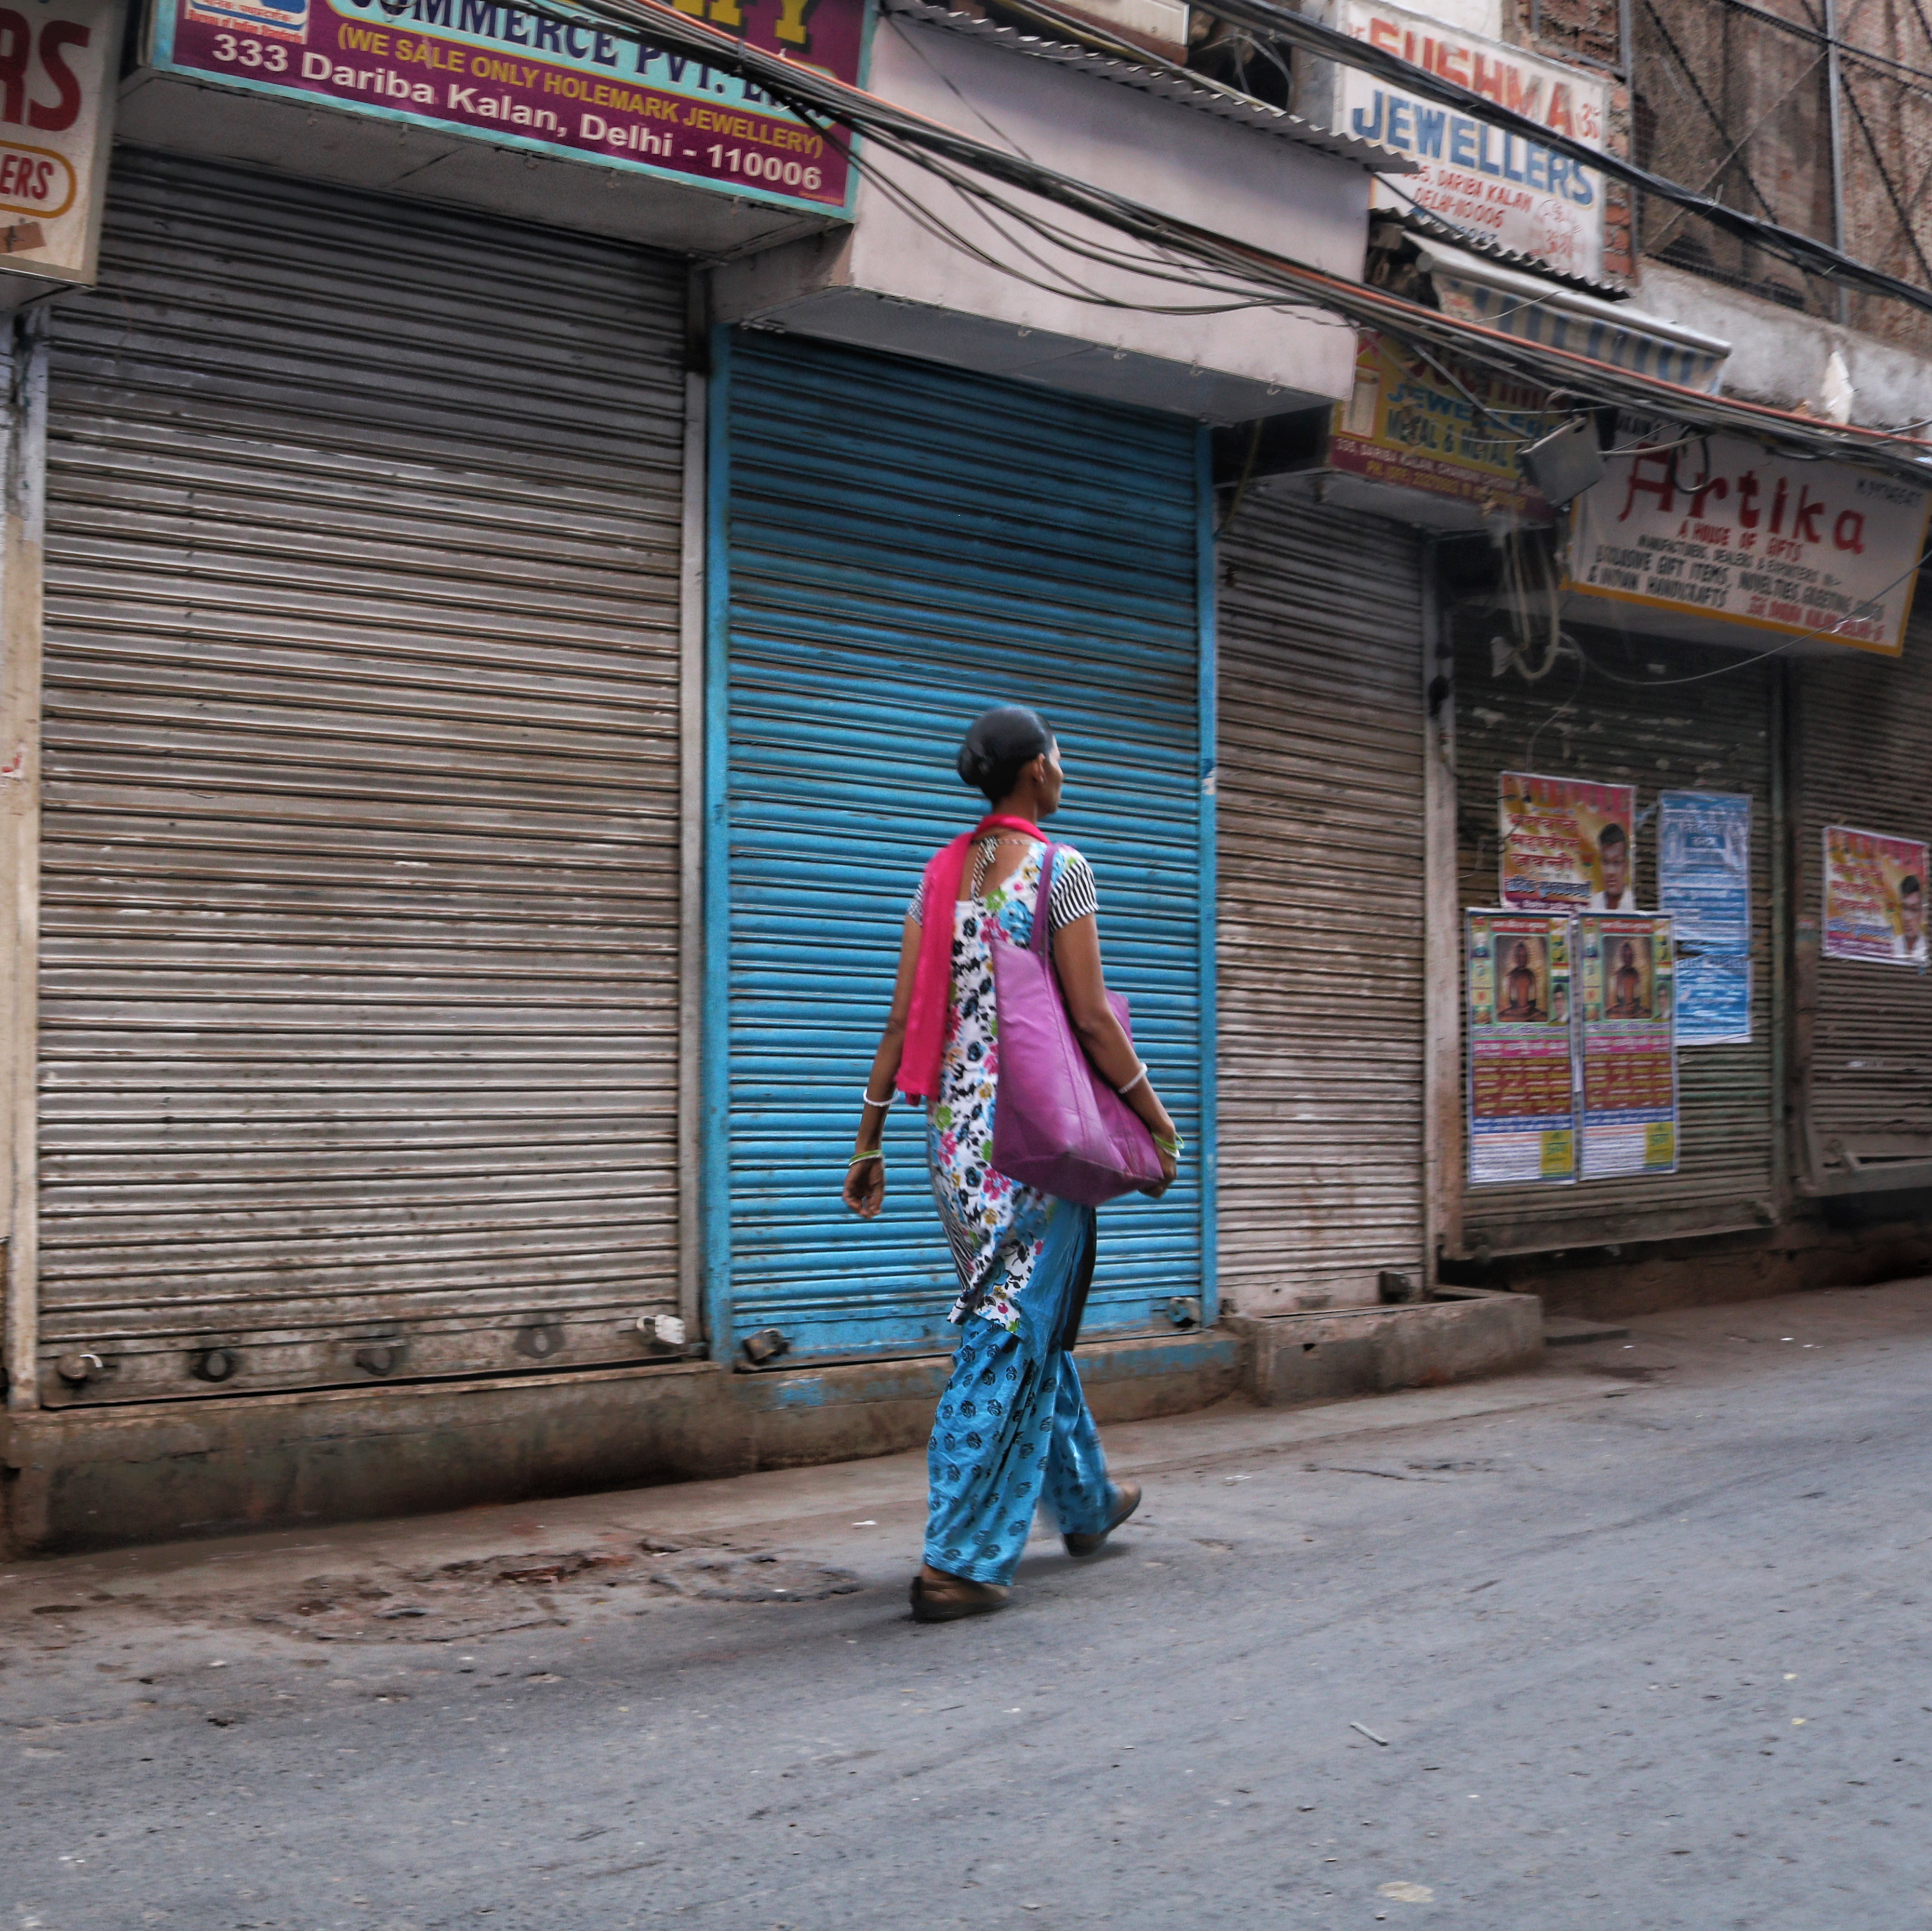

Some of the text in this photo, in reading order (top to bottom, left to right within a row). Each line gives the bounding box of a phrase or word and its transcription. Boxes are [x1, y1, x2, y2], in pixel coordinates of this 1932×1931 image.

[338, 23, 823, 159] (WE SALE ONLY HOLEMARK JEWELLERY)
[345, 0, 618, 70] MMERCE
[212, 34, 288, 72] 333
[301, 51, 435, 104] Dariba
[447, 83, 568, 138] Kalan,
[579, 113, 674, 157] Delhi
[707, 144, 823, 190] 110006
[1352, 90, 1593, 206] JEWELLERS
[1437, 169, 1484, 197] DARIBA
[1485, 184, 1534, 213] KALAN
[1617, 442, 1867, 554] Artika
[1676, 519, 1803, 562] A HOUSE OF GIFTS
